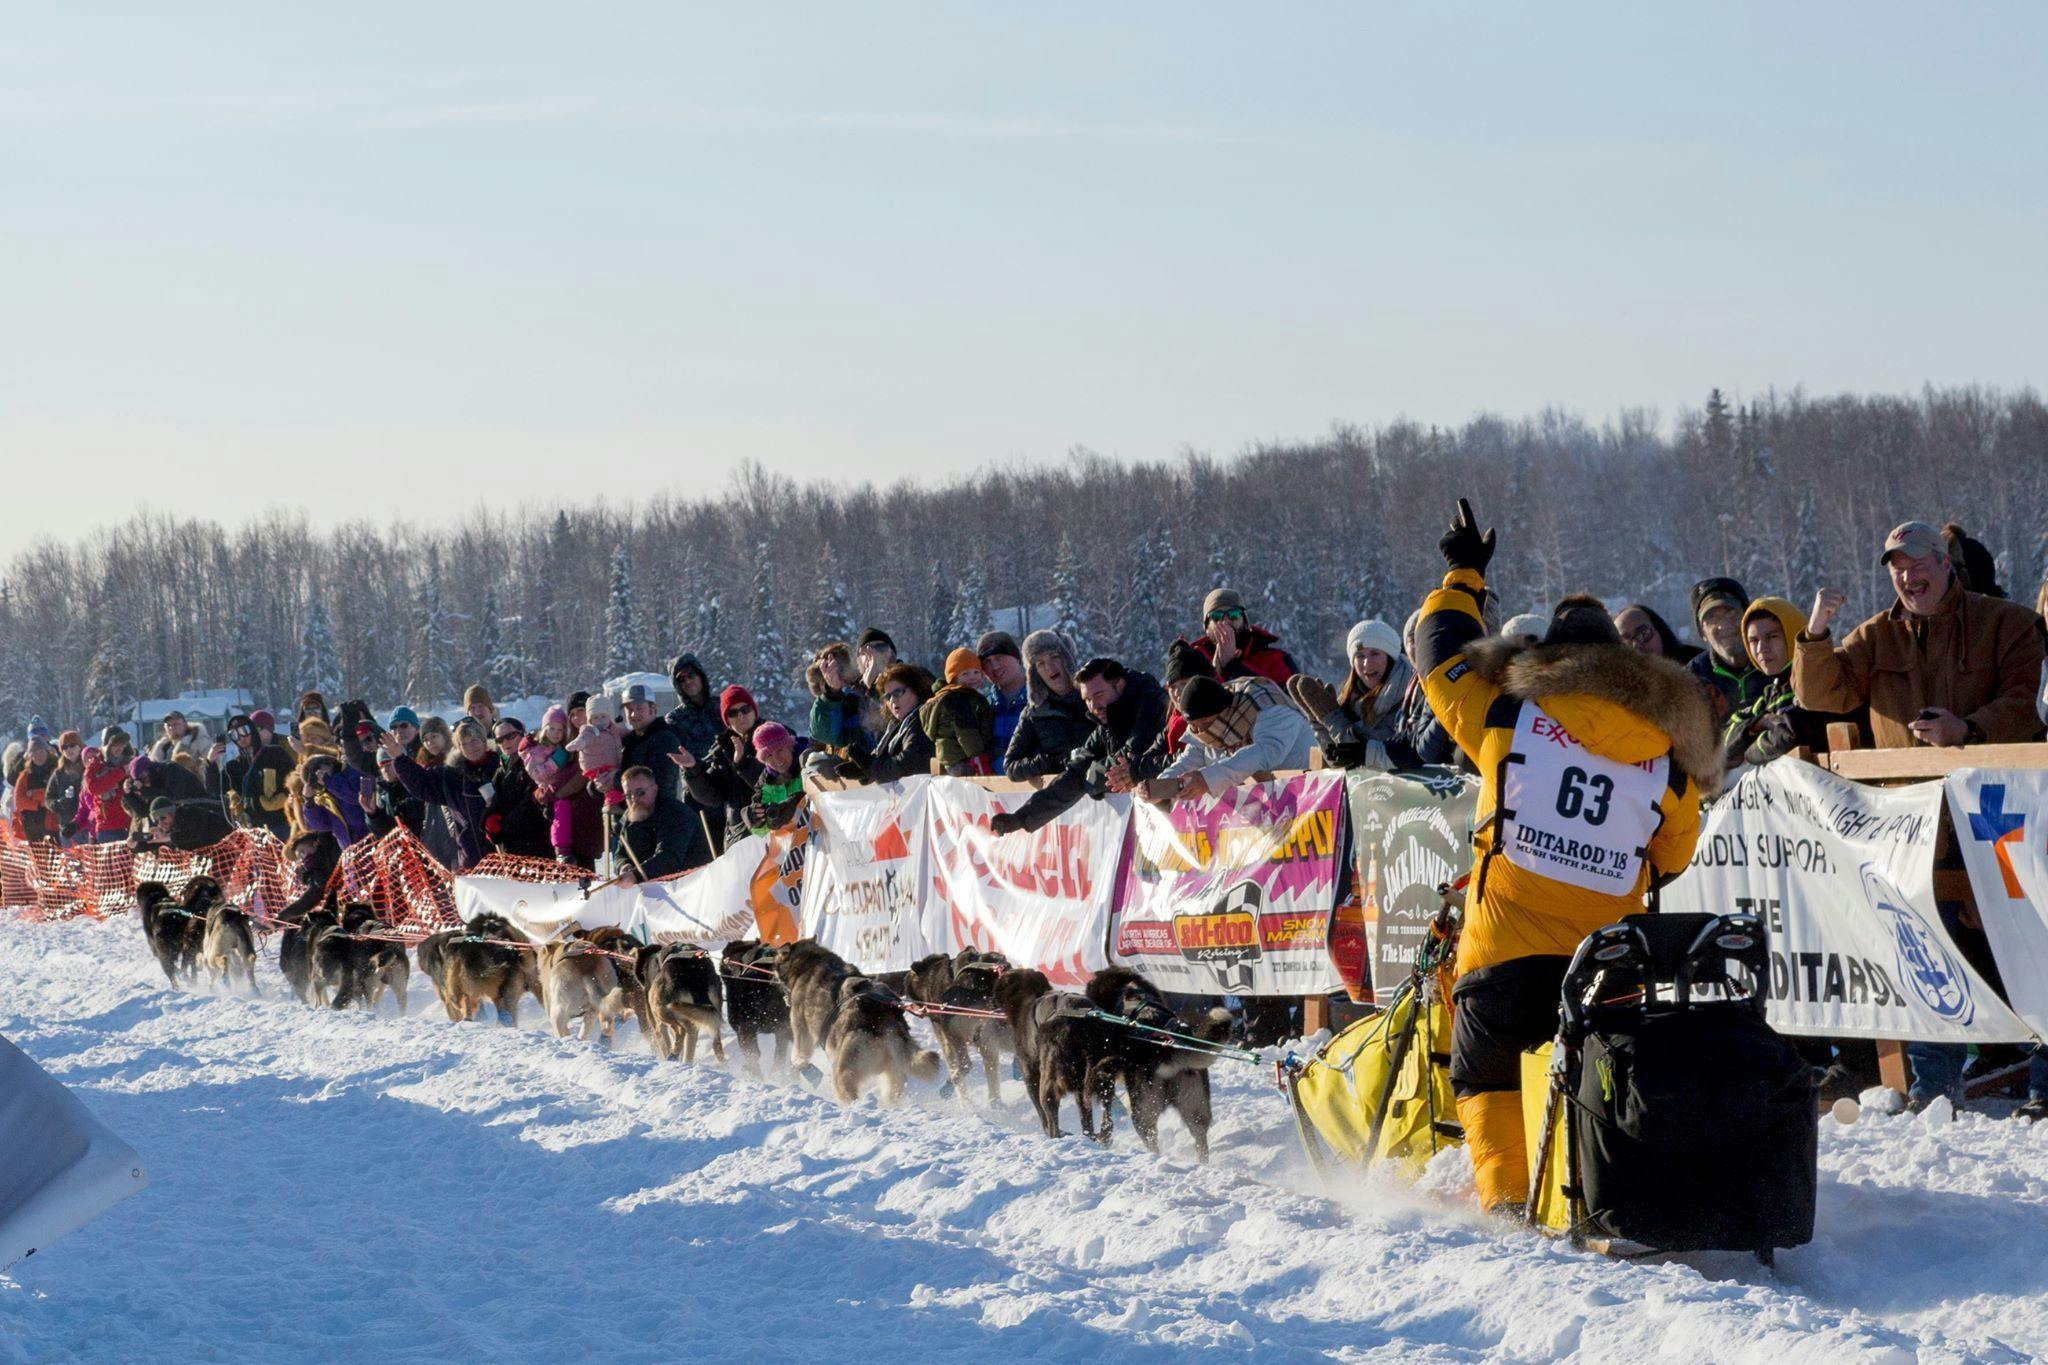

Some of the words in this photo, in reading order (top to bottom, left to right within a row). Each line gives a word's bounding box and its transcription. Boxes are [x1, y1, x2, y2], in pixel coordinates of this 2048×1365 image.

[1555, 766, 1614, 826] 63
[1516, 824, 1606, 865] IDITAROD
[1609, 850, 1629, 871] '18
[1516, 843, 1547, 860] MUSH
[1549, 852, 1579, 868] WITH
[1581, 862, 1624, 880] P.R.I.D.E.
[1383, 849, 1410, 914] JACK
[1180, 914, 1253, 948] ski-doo
[1281, 917, 1327, 930] SNOW
[1735, 897, 1783, 934] THE
[1266, 929, 1326, 943] MACHIN
[1381, 943, 1399, 962] The
[1398, 944, 1416, 963] Last
[1196, 947, 1250, 961] Racing
